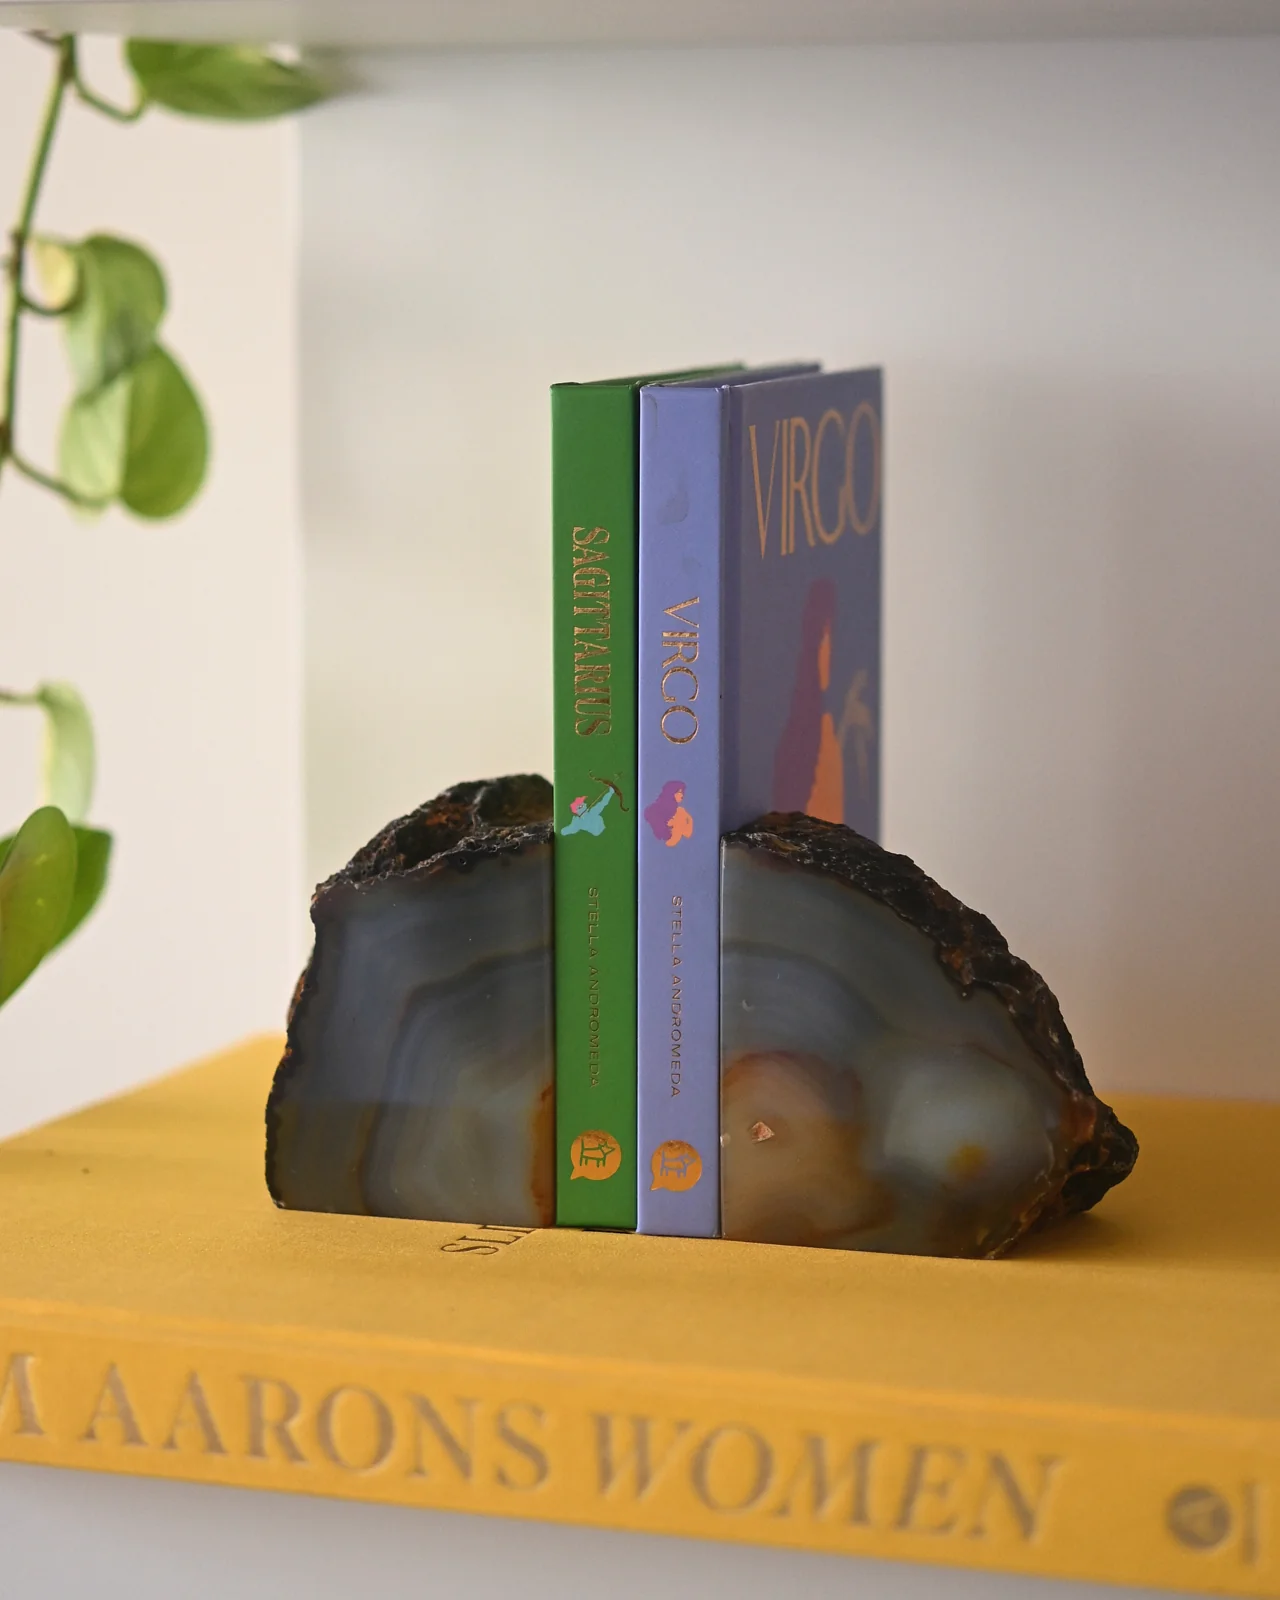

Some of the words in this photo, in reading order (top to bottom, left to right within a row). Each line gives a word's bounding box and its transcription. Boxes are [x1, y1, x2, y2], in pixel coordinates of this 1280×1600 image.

[749, 402, 881, 560] VIRGO
[572, 526, 612, 737] SAGITTARIUS
[660, 596, 700, 745] VIRGO
[588, 887, 599, 959] STELLA
[671, 895, 683, 968] STELLA
[589, 965, 599, 1088] ANDROMEDA
[671, 974, 683, 1098] ANDROMEDA
[78, 1360, 552, 1494] AARONS
[592, 1410, 1064, 1547] WOMEN
